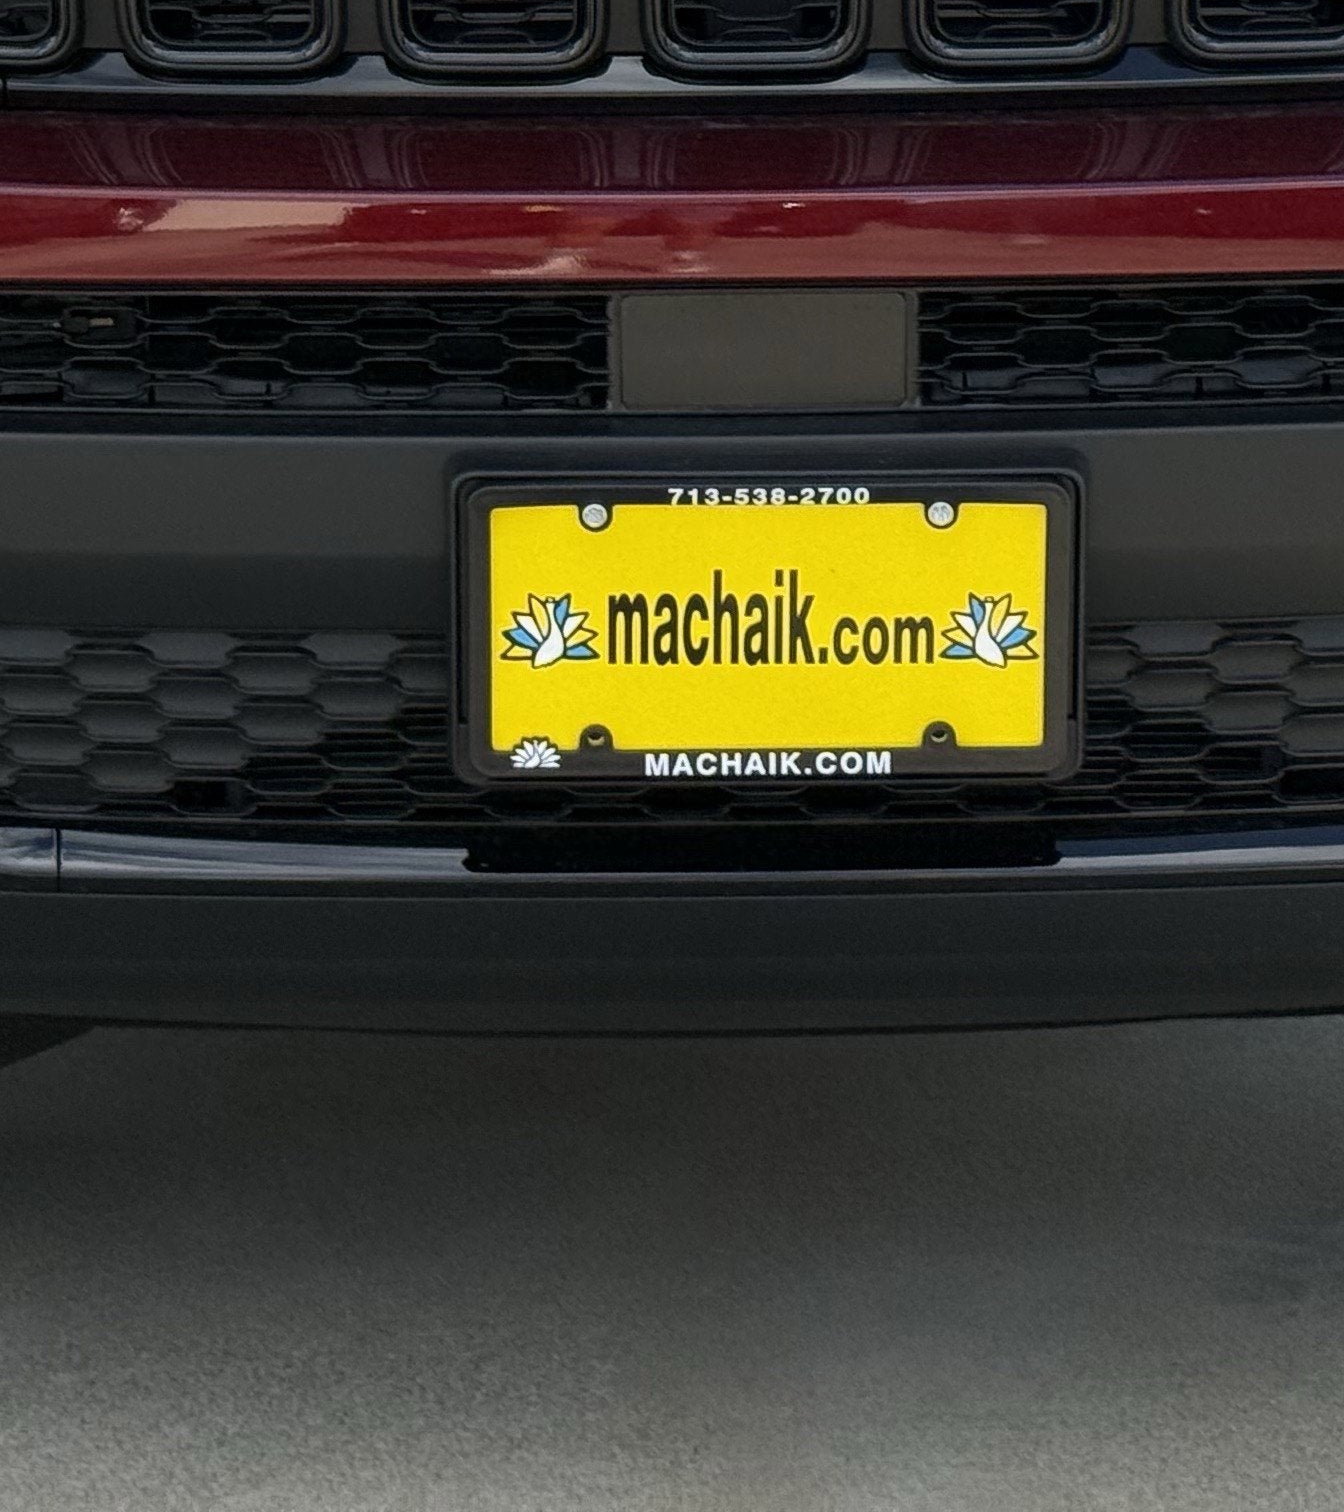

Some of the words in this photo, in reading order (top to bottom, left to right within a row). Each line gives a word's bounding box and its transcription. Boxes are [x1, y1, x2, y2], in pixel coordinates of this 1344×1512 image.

[667, 487, 871, 506] 713-538-2700
[607, 569, 935, 665] machaik.com
[644, 751, 892, 777] MACHAIK.COM
